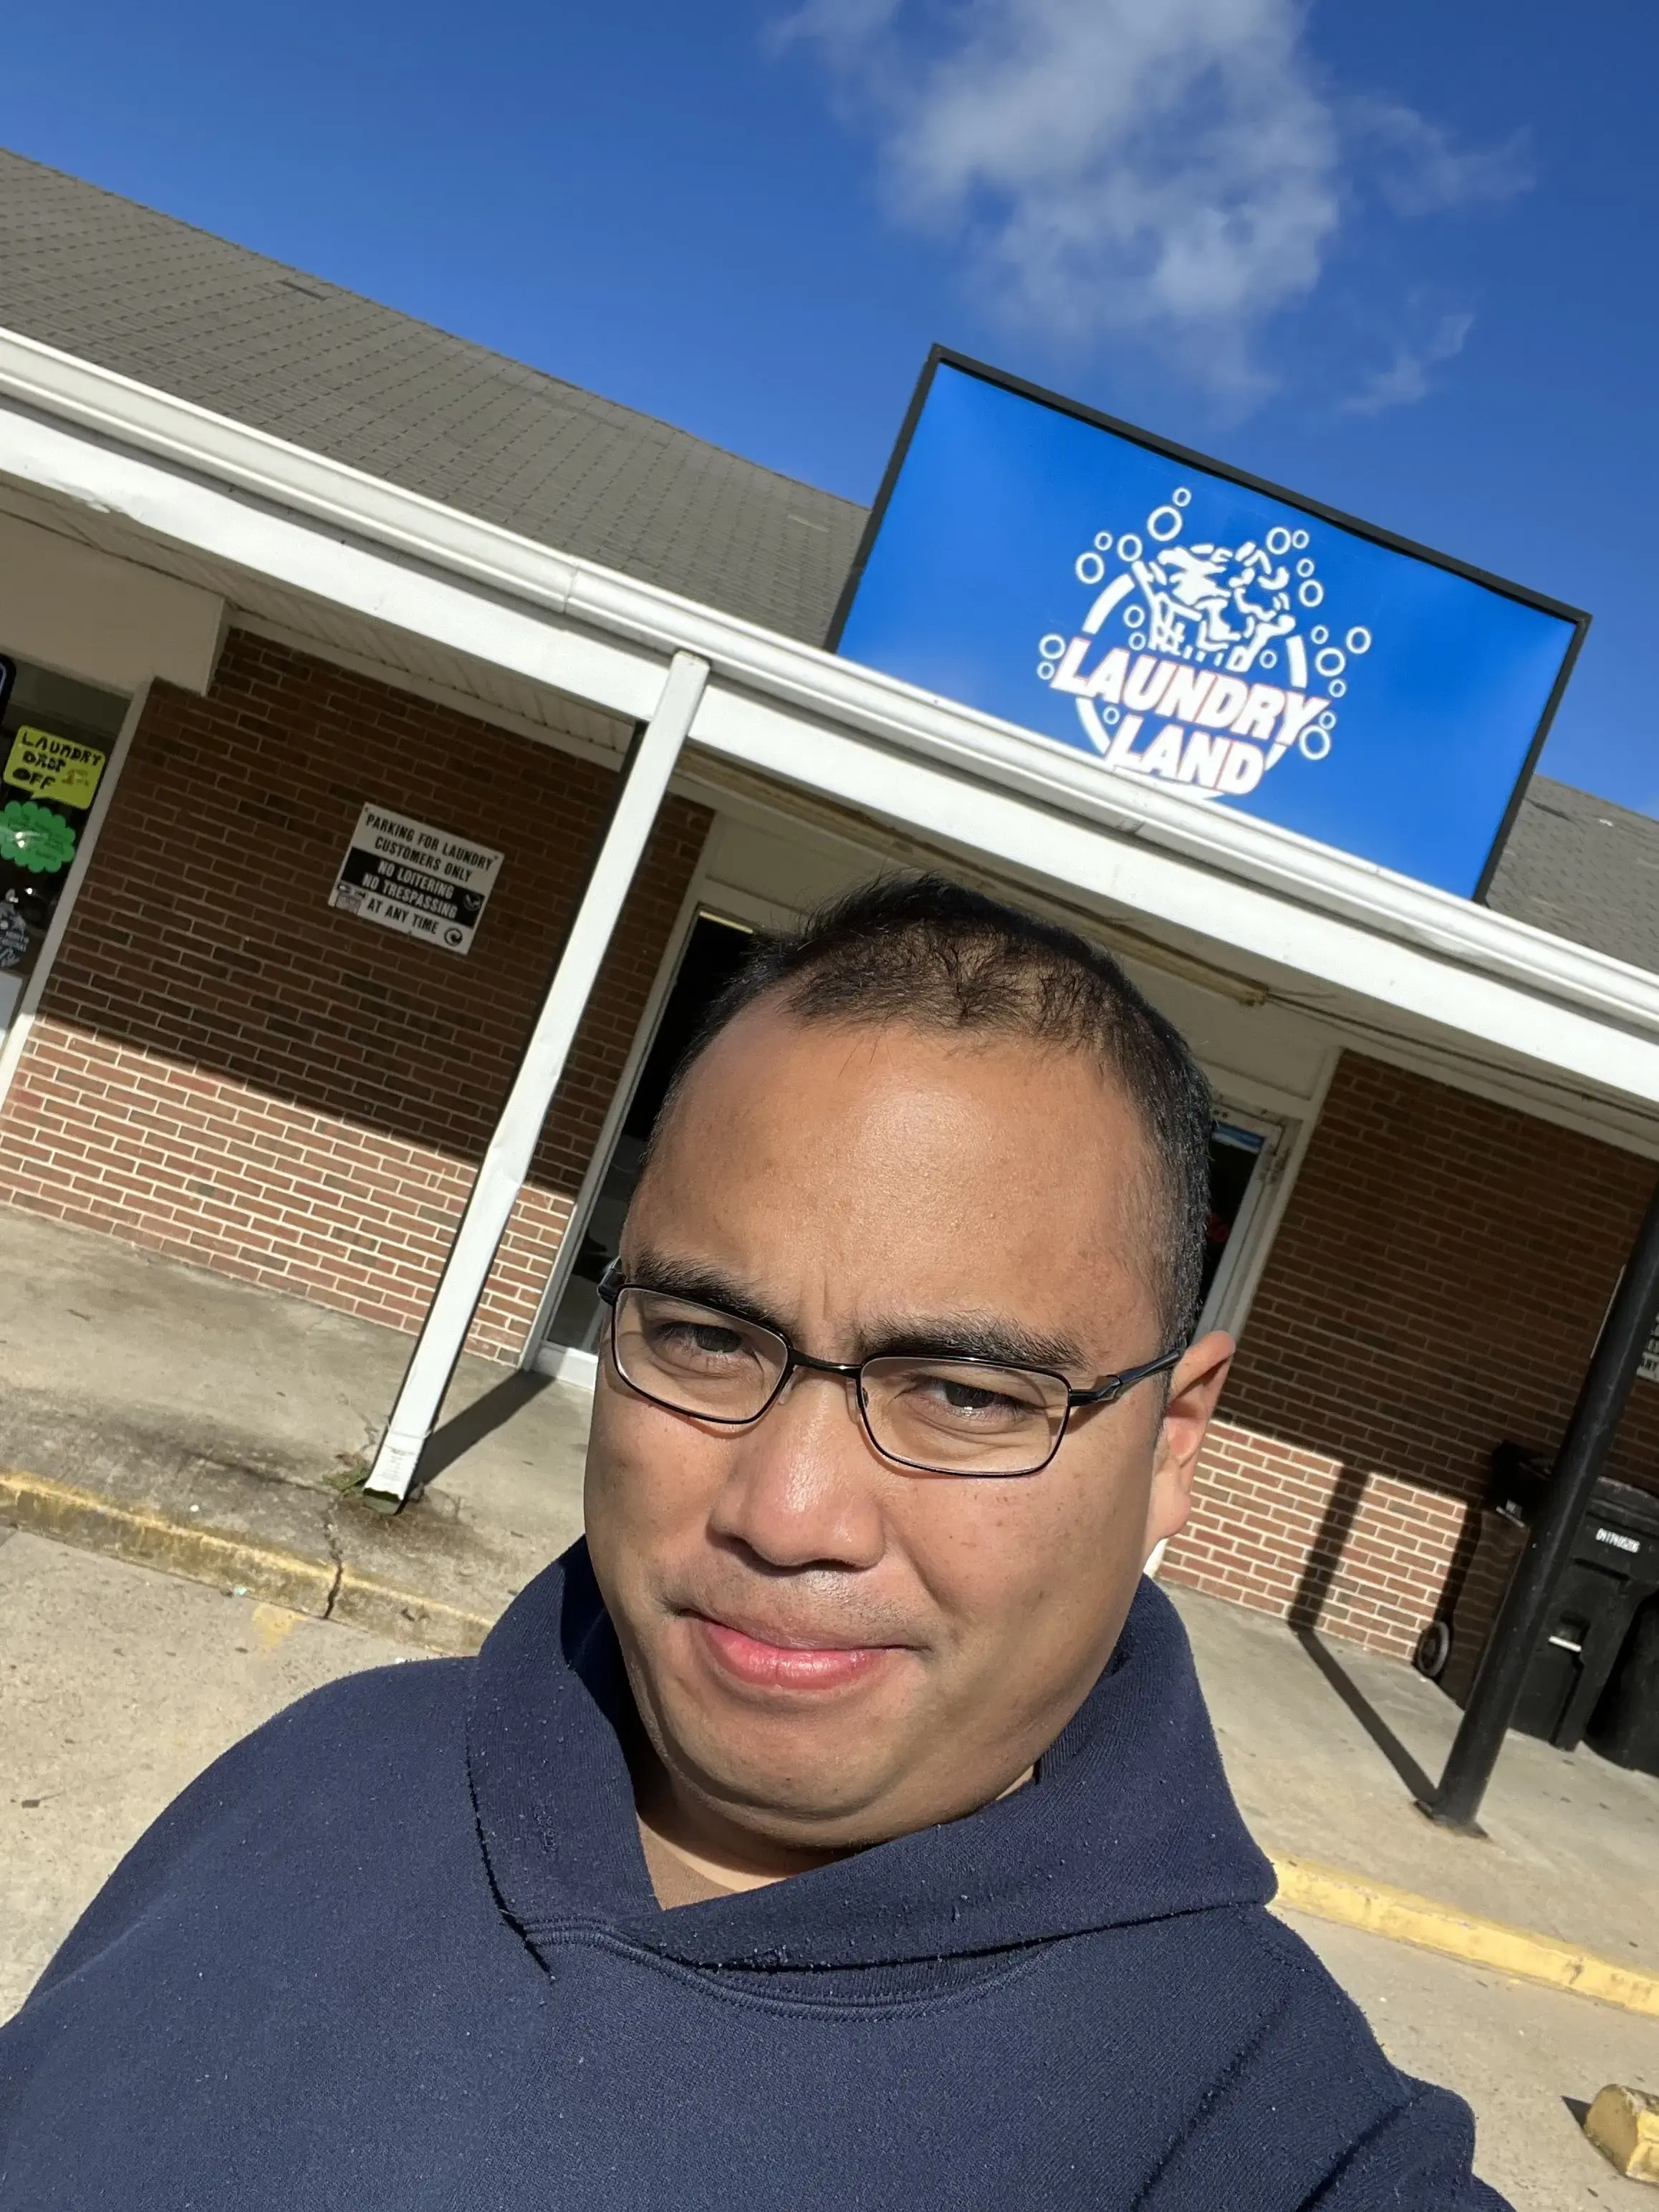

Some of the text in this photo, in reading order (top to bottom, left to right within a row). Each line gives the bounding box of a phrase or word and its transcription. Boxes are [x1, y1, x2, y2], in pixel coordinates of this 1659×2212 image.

[1049, 636, 1331, 746] LAUNDRY
[21, 731, 102, 766] LAUNDRY
[22, 750, 66, 772] DROP
[1105, 714, 1265, 796] LAND
[12, 767, 56, 789] OFF
[366, 813, 494, 871] PARKING FOR LAUNDRY
[375, 836, 473, 883] CUSTOMERS ONLY
[362, 872, 458, 919] NO TRESPASSING
[378, 860, 455, 900] NO LOITERING
[367, 896, 440, 935] AT ANY TIME
